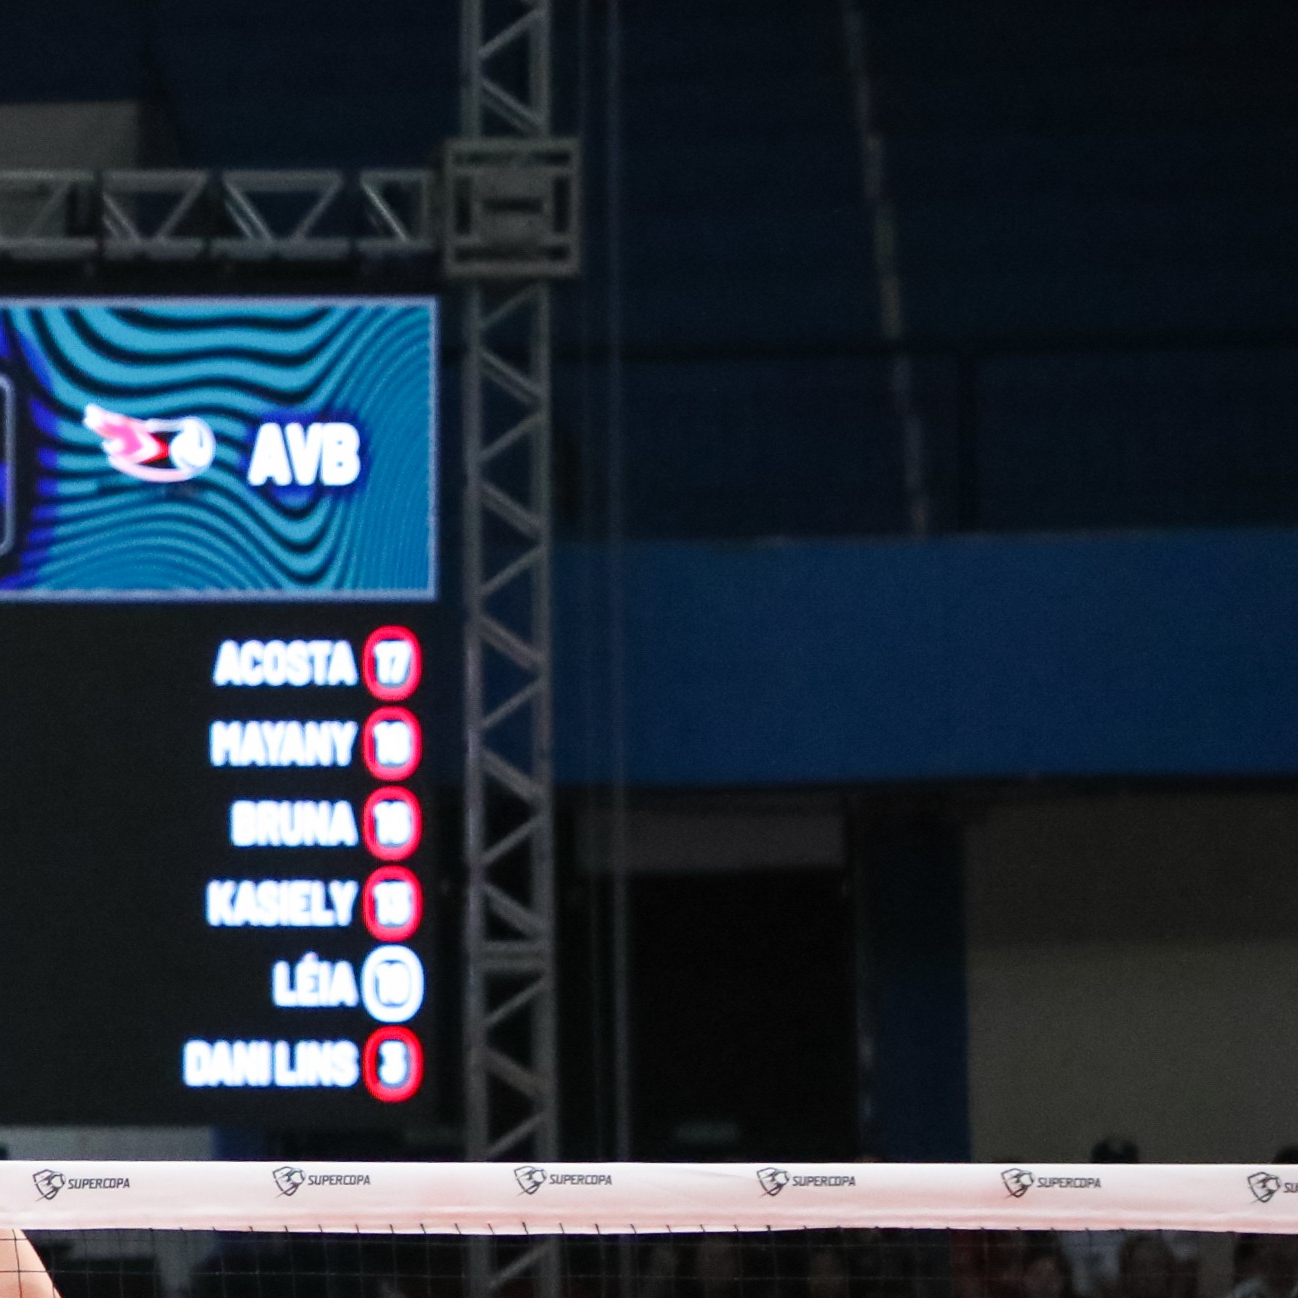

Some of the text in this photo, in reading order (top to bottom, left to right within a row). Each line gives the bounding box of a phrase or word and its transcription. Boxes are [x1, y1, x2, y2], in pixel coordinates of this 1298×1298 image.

[246, 423, 361, 487] AVB
[212, 639, 358, 687] ACOSTA
[209, 719, 358, 767] MAYANY
[230, 800, 358, 846] BRUNA
[205, 879, 358, 926] KASIELY
[182, 1040, 406, 1087] DANI LINS 3
[67, 1177, 131, 1190] SUPERCOPA
[308, 1174, 371, 1186] SUPERCOPA
[549, 1173, 613, 1186] SUPERCOPA
[792, 1175, 857, 1188] SUPERCOPA
[1037, 1176, 1102, 1189] SUPERCOPA
